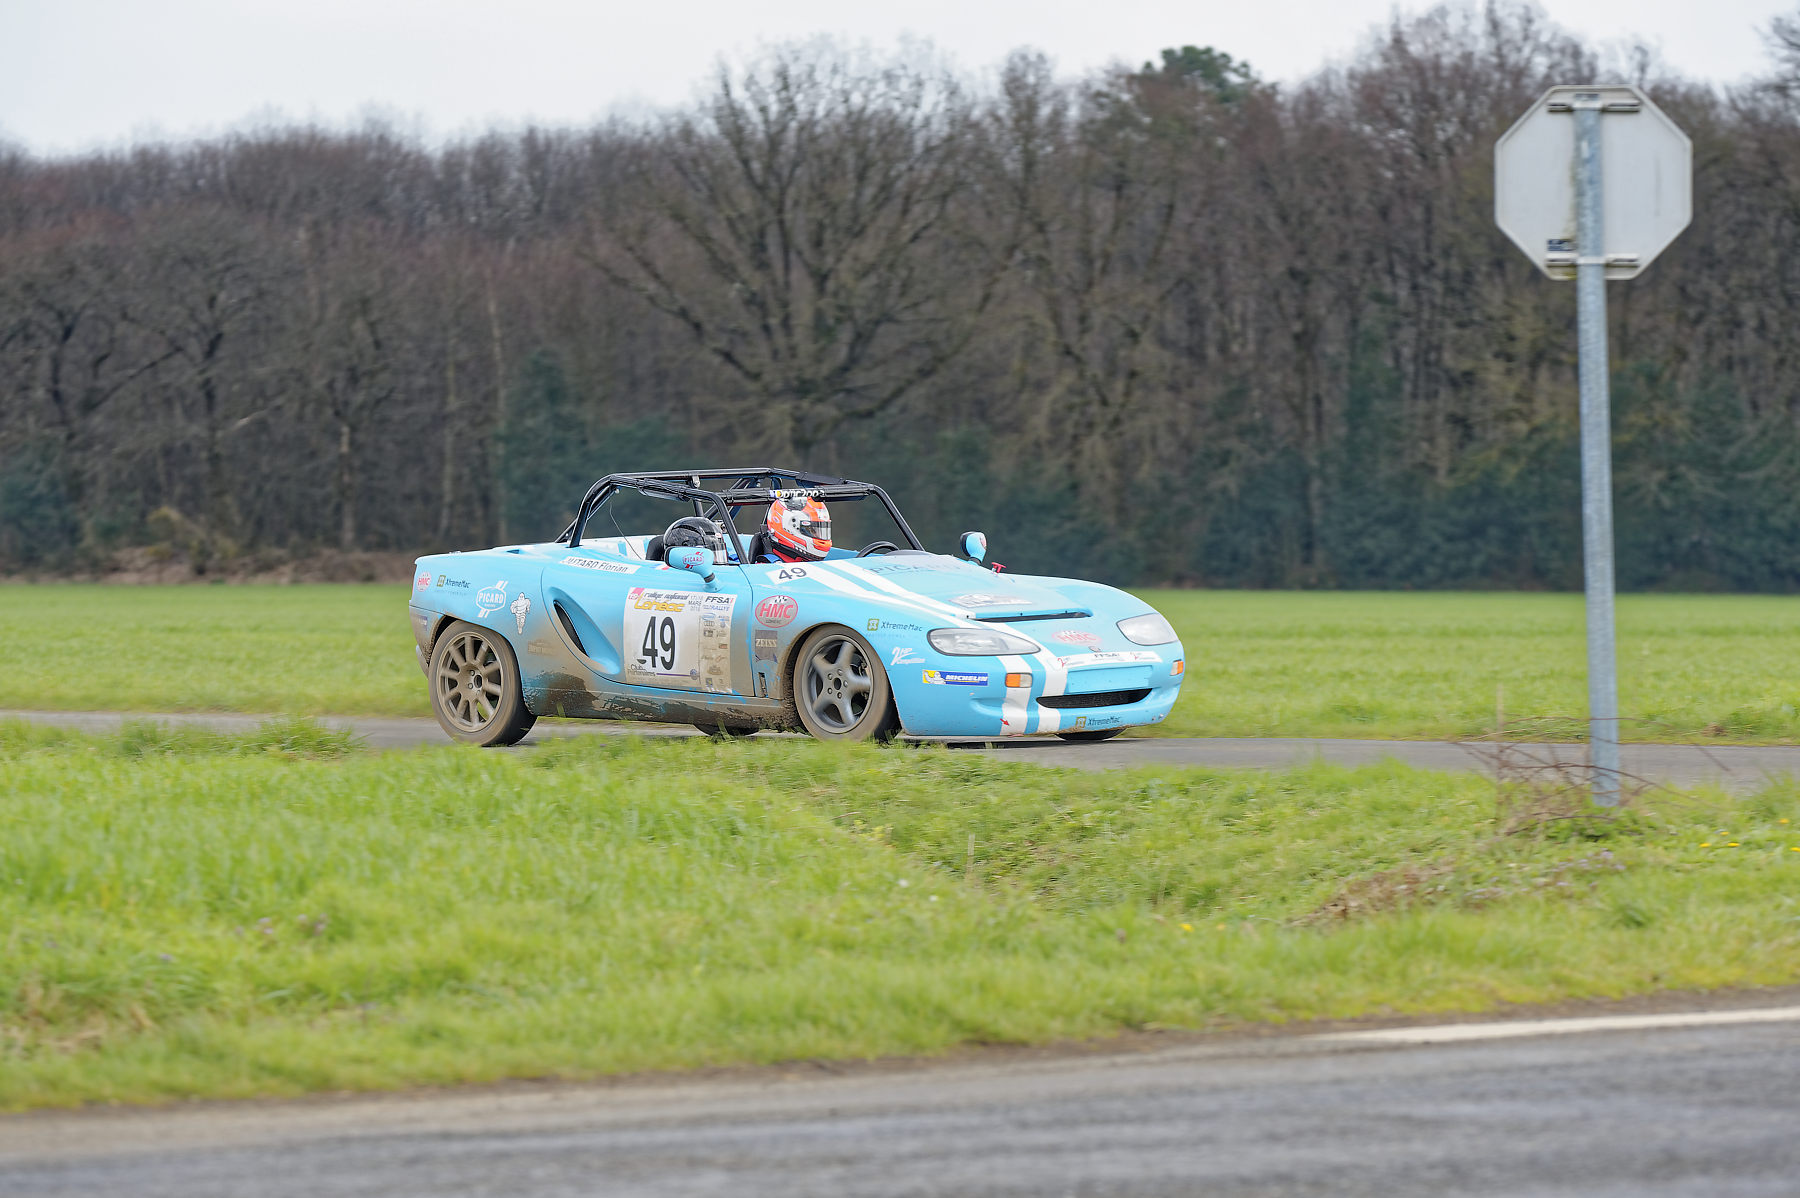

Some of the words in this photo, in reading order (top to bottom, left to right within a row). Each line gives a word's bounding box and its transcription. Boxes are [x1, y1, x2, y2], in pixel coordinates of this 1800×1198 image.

[684, 555, 703, 563] PICARD
[598, 562, 629, 573] Florian
[778, 567, 807, 580] 49
[478, 592, 504, 604] PICARD
[705, 596, 730, 604] FFSA
[759, 603, 794, 619] HMC
[880, 621, 923, 632] XtremeMac
[642, 616, 676, 670] 49
[755, 638, 777, 648] ZEISS
[944, 674, 988, 682] MICHELIN
